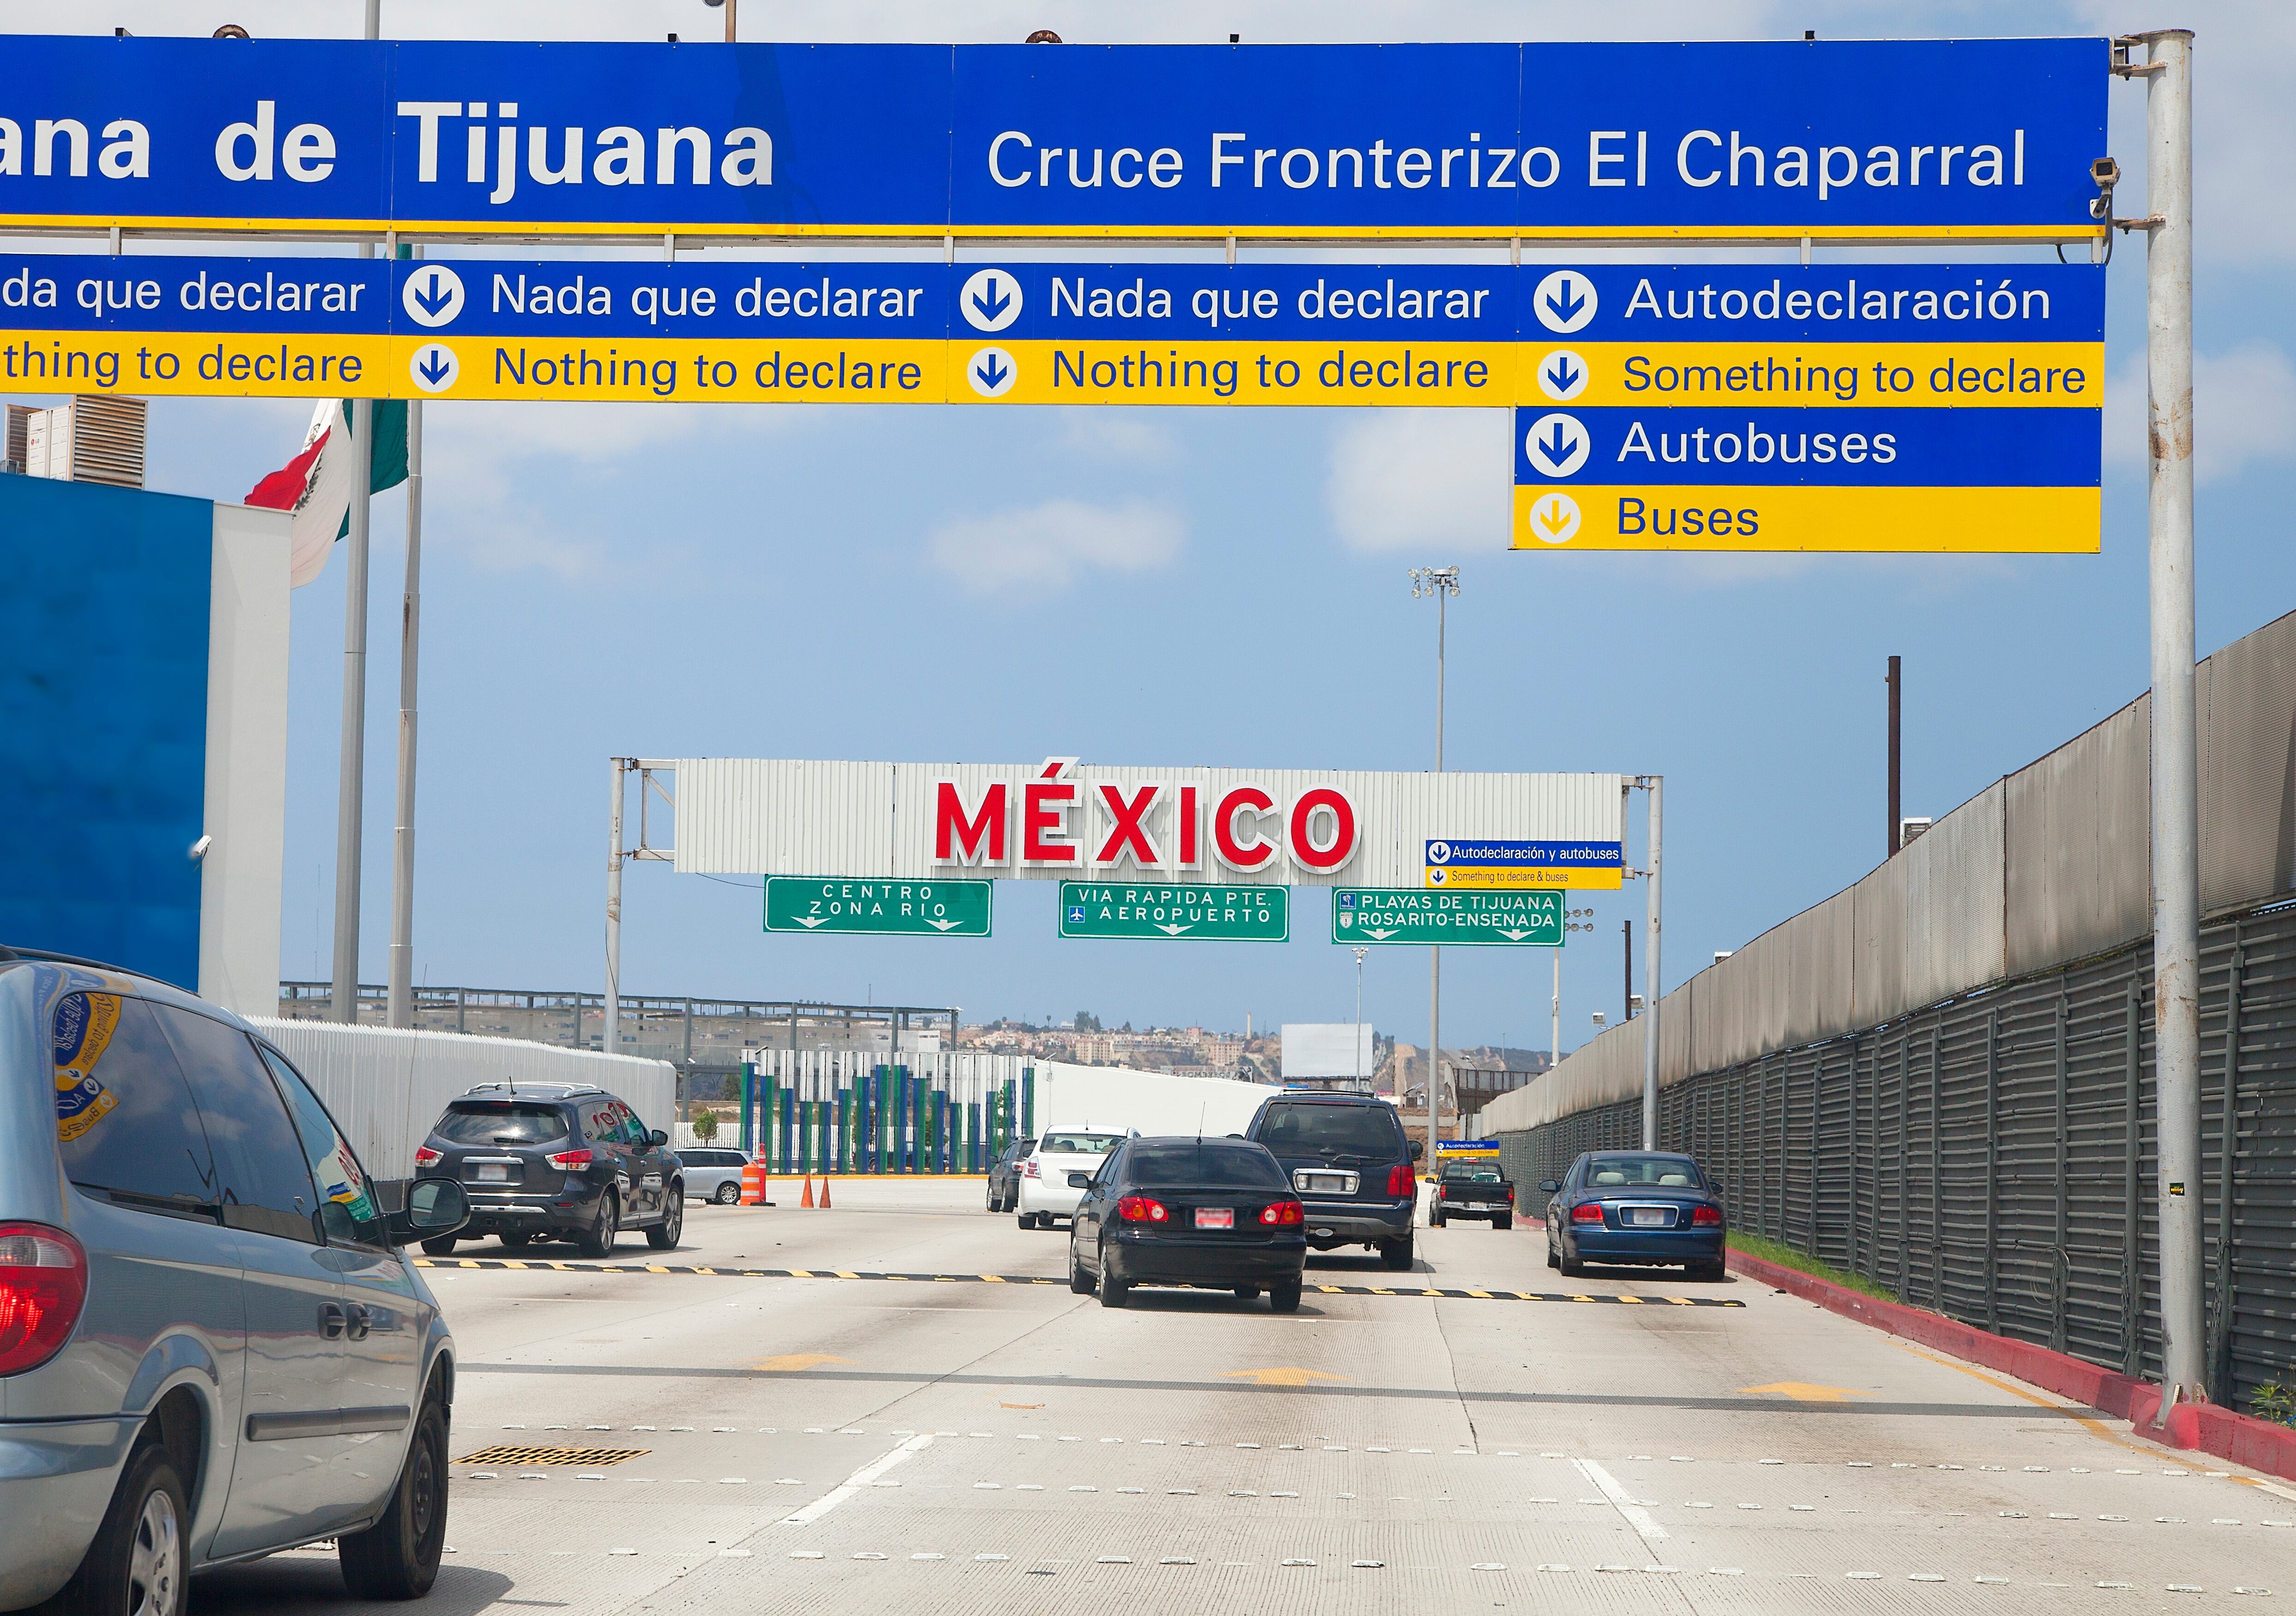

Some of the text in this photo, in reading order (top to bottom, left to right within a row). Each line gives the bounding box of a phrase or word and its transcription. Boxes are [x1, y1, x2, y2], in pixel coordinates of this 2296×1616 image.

[216, 101, 336, 182] de
[397, 102, 773, 204] Tijuana
[989, 129, 2024, 200] Cruce Fronterizo El Chaparral
[77, 280, 161, 317] que
[180, 271, 366, 312] declarar
[493, 274, 923, 325] Nada que declarar
[1052, 278, 1489, 328] Nada que declarar
[1625, 279, 2049, 320] Autodeclaración
[0, 341, 362, 388] thing to declare
[496, 348, 921, 397] Nothing to declare
[1054, 350, 1488, 397] Nothing to declare
[1624, 356, 2085, 401] Something to declare
[1617, 422, 1897, 463] Autobuses
[1619, 497, 1759, 536] Buses
[936, 763, 1355, 867] MÉXICO
[1452, 845, 1619, 862] Autodeclaración y autobuses
[823, 884, 931, 900] CENTRO
[1078, 889, 1271, 906] VIA RAPIDA PTE.
[1452, 871, 1568, 883] Something to declare & buses
[810, 901, 946, 916] ZONA RIO
[1099, 906, 1270, 922] AEROPUERTO
[1358, 912, 1555, 927] ROSARITO-ENSENADA
[1362, 895, 1555, 910] PLAYAS DE TIJUANA
